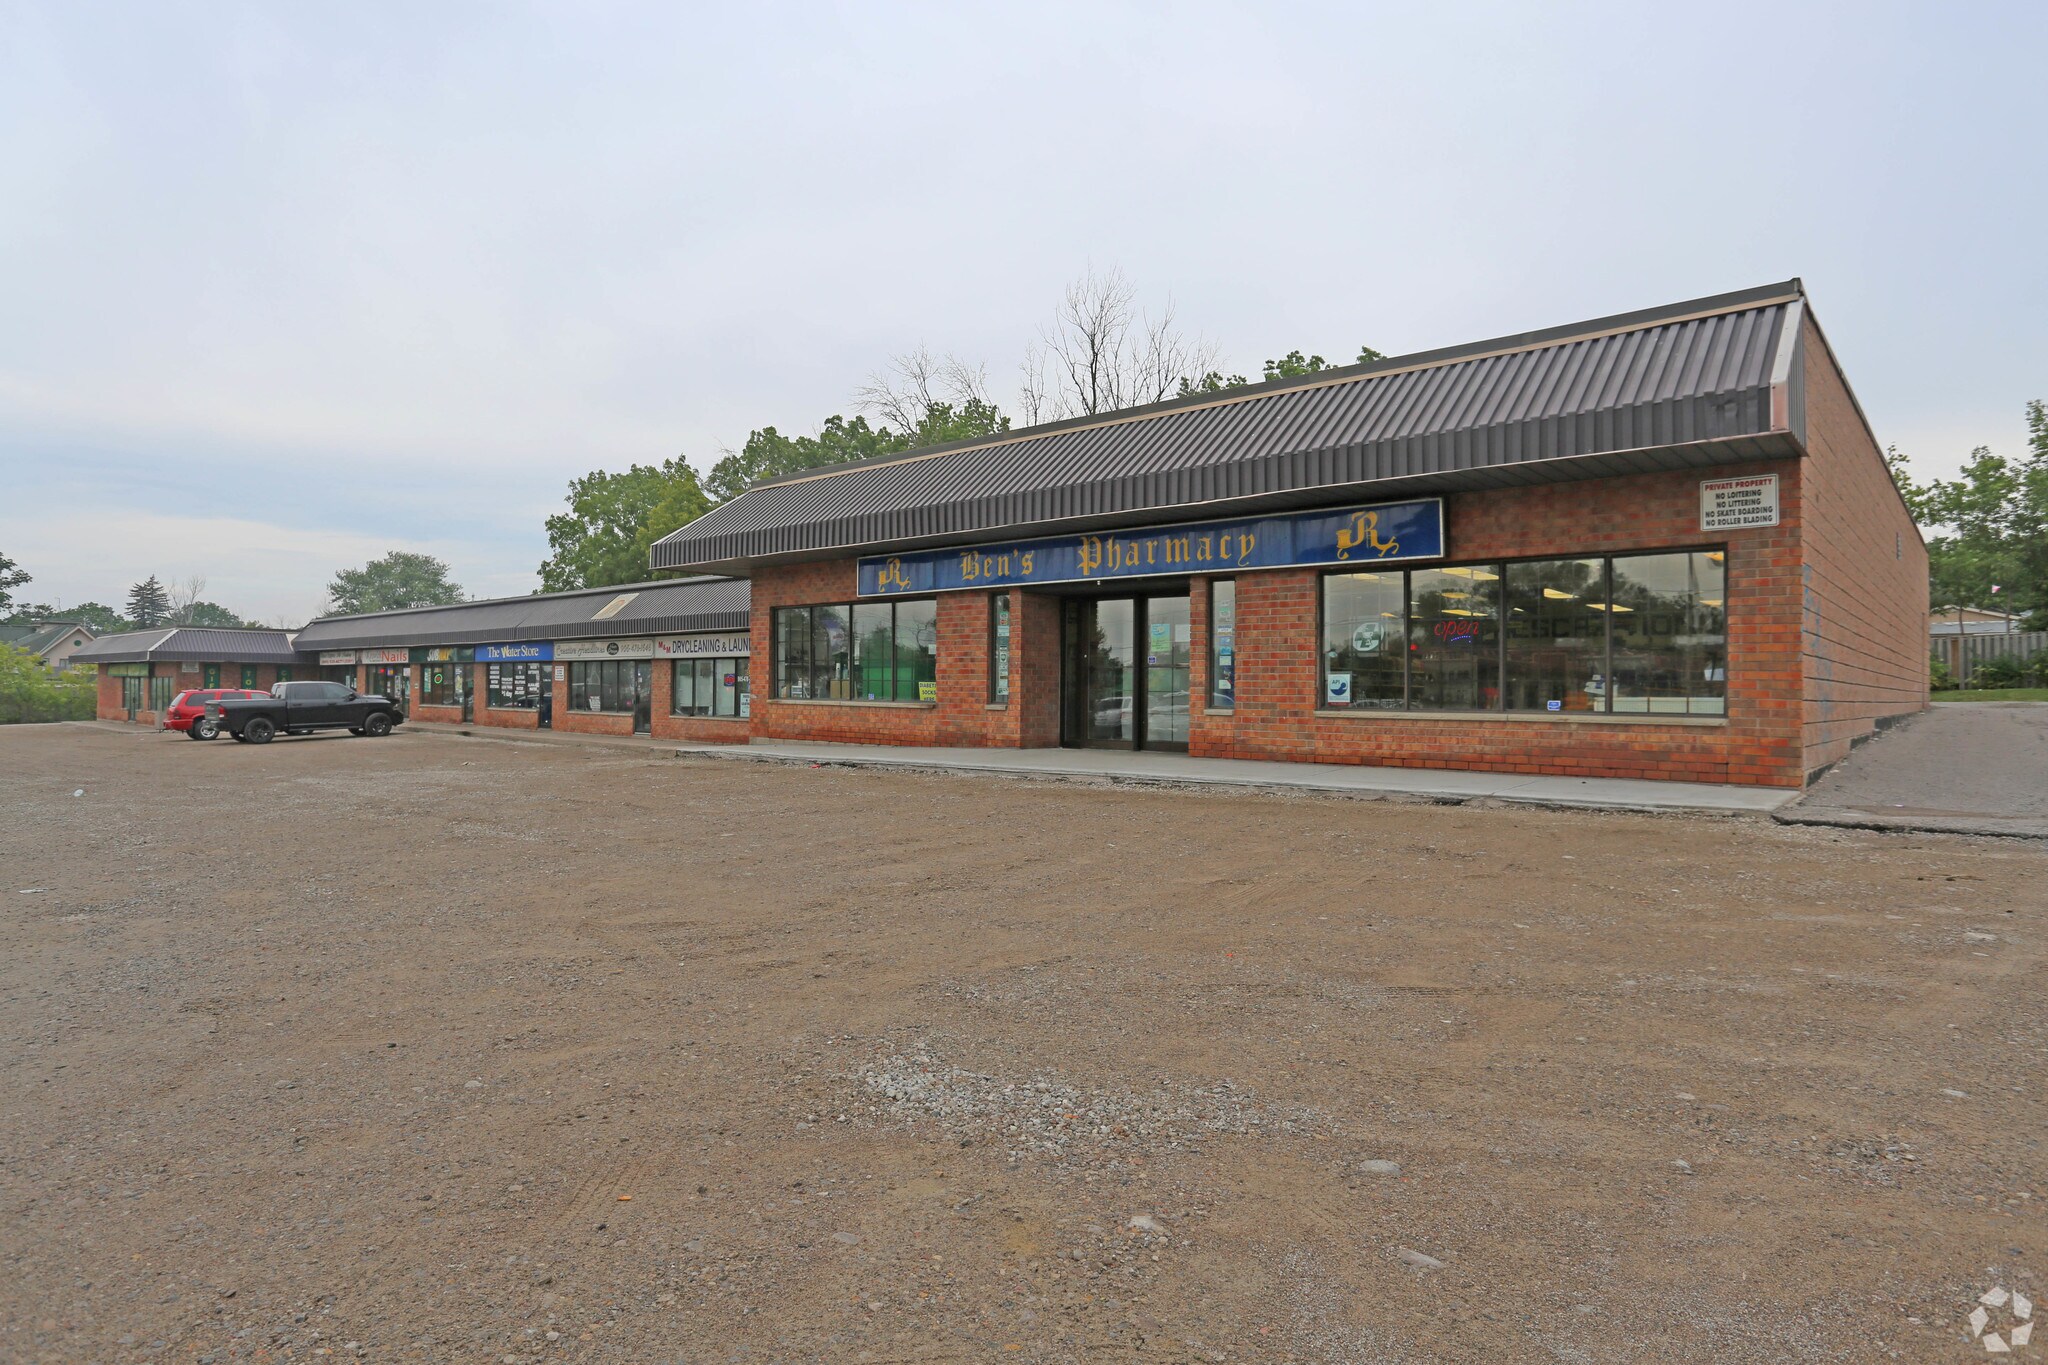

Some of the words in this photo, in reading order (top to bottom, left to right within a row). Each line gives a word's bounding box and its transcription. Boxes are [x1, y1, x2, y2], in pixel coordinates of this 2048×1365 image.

[1705, 482, 1733, 491] PRIVATE
[1735, 478, 1772, 488] PROPERTY
[1715, 492, 1725, 500] NO
[1727, 489, 1762, 499] LOITERING
[1728, 498, 1761, 508] LITTERING
[1717, 509, 1736, 517] SKATE
[1738, 506, 1773, 516] BOARDING
[1718, 517, 1741, 526] ROLLER
[1743, 515, 1773, 524] BLADING
[960, 548, 1034, 581] Ben's
[1077, 533, 1256, 576] Pharmacy
[1434, 620, 1479, 641] open
[487, 646, 500, 658] The
[501, 645, 520, 658] Water
[520, 644, 539, 657] Store
[672, 639, 720, 653] DRYCLEANING
[721, 642, 727, 652] &
[381, 650, 408, 662] Nails
